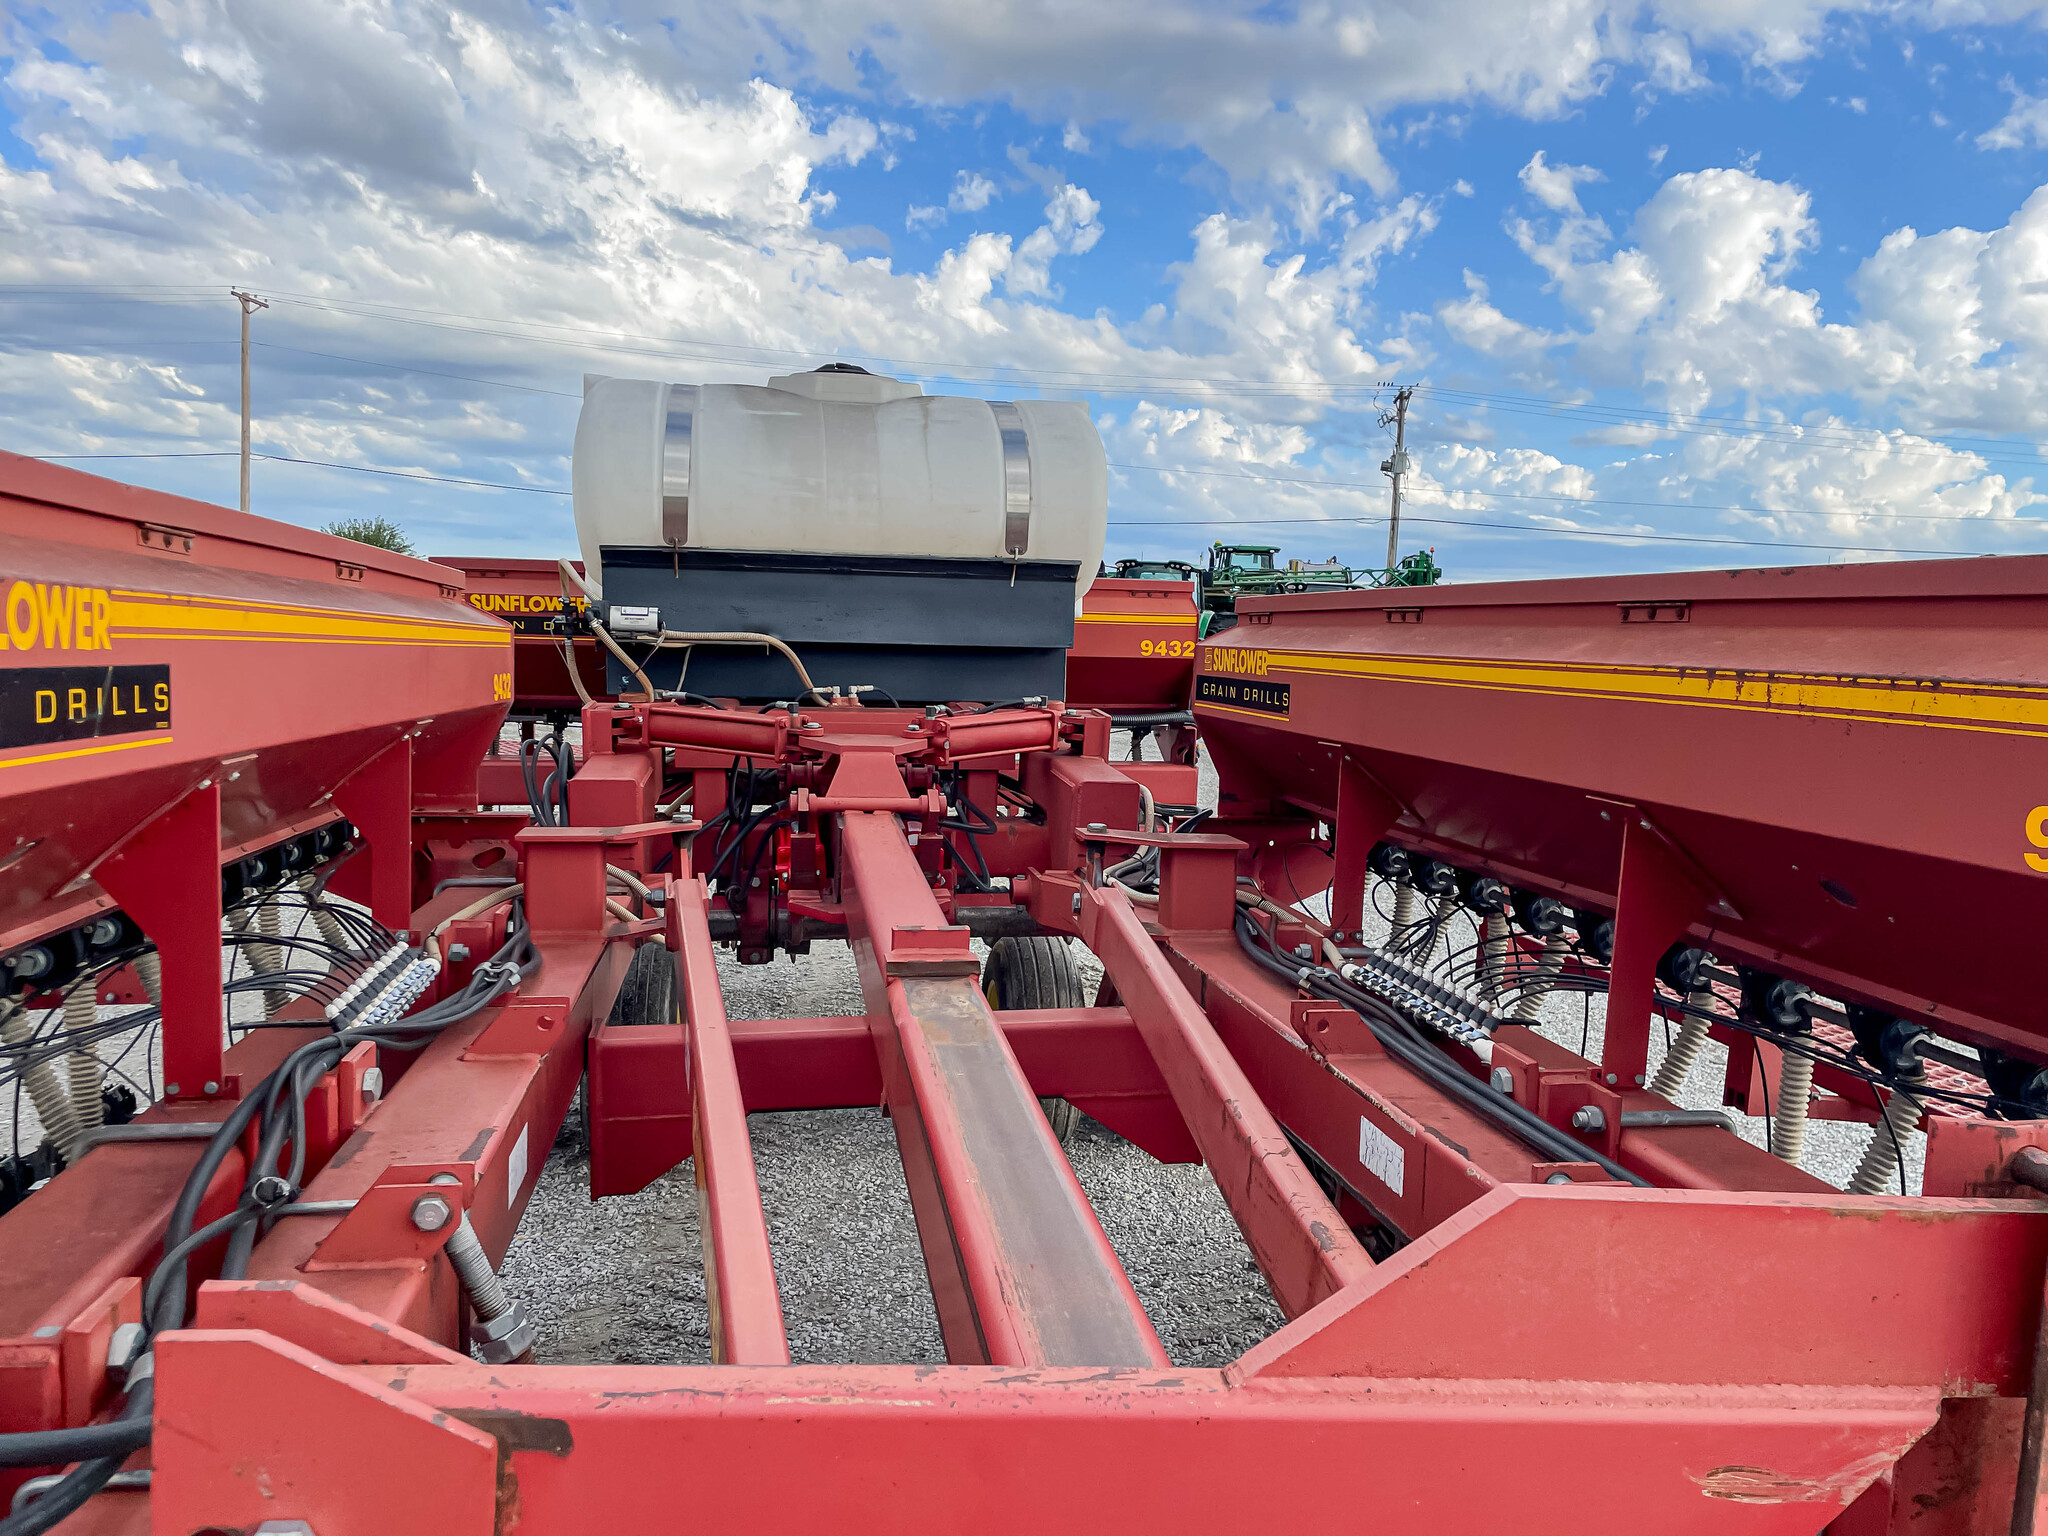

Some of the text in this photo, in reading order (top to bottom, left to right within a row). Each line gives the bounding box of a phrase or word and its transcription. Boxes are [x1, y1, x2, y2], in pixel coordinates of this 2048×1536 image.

[0, 580, 112, 651] OWER
[1140, 640, 1196, 657] 9432
[1213, 647, 1268, 676] SUNFLOWER
[492, 673, 512, 701] 9432
[1202, 682, 1289, 707] GRAIN DRILLS
[35, 683, 169, 724] DRILLS
